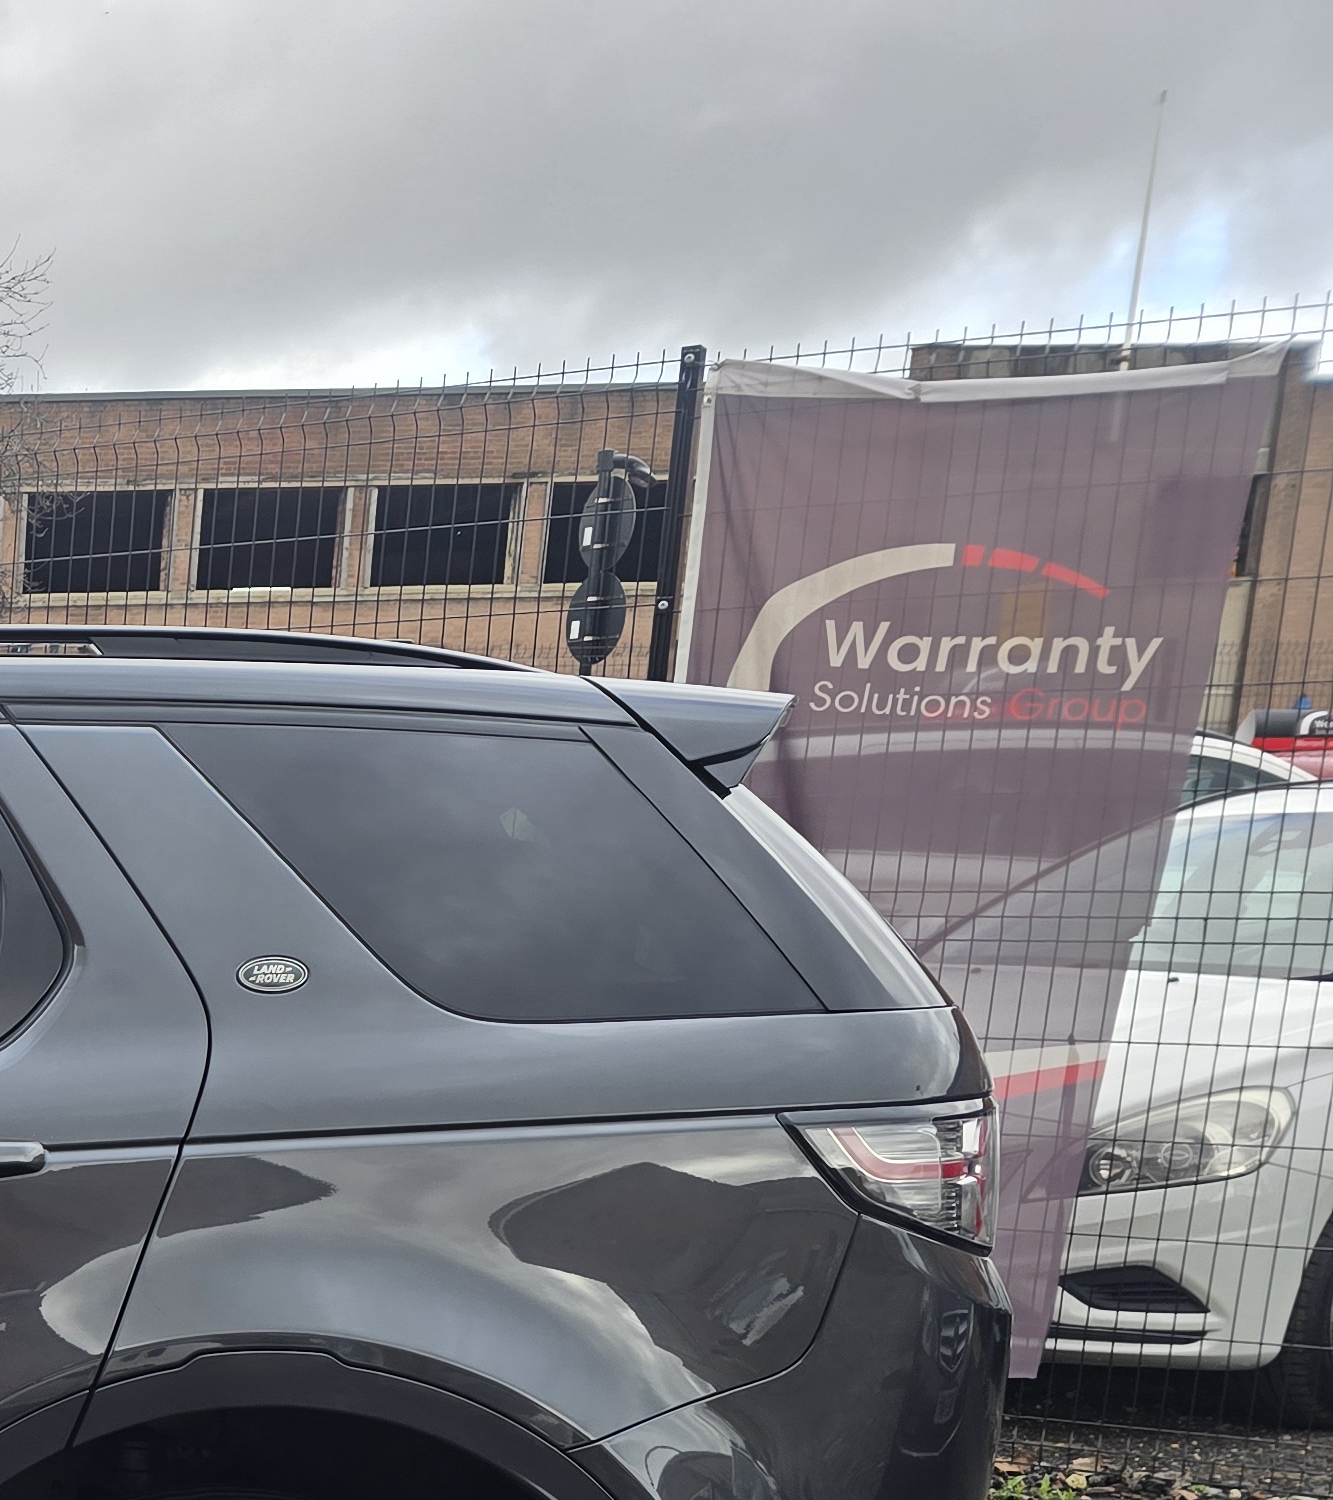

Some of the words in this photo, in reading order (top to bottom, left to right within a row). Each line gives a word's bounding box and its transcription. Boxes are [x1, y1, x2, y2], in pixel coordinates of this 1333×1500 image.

[825, 619, 1163, 692] Warranty
[809, 680, 992, 720] Solutions
[1009, 687, 1149, 731] Group
[253, 965, 285, 974] LAND
[255, 974, 295, 984] ROVER
